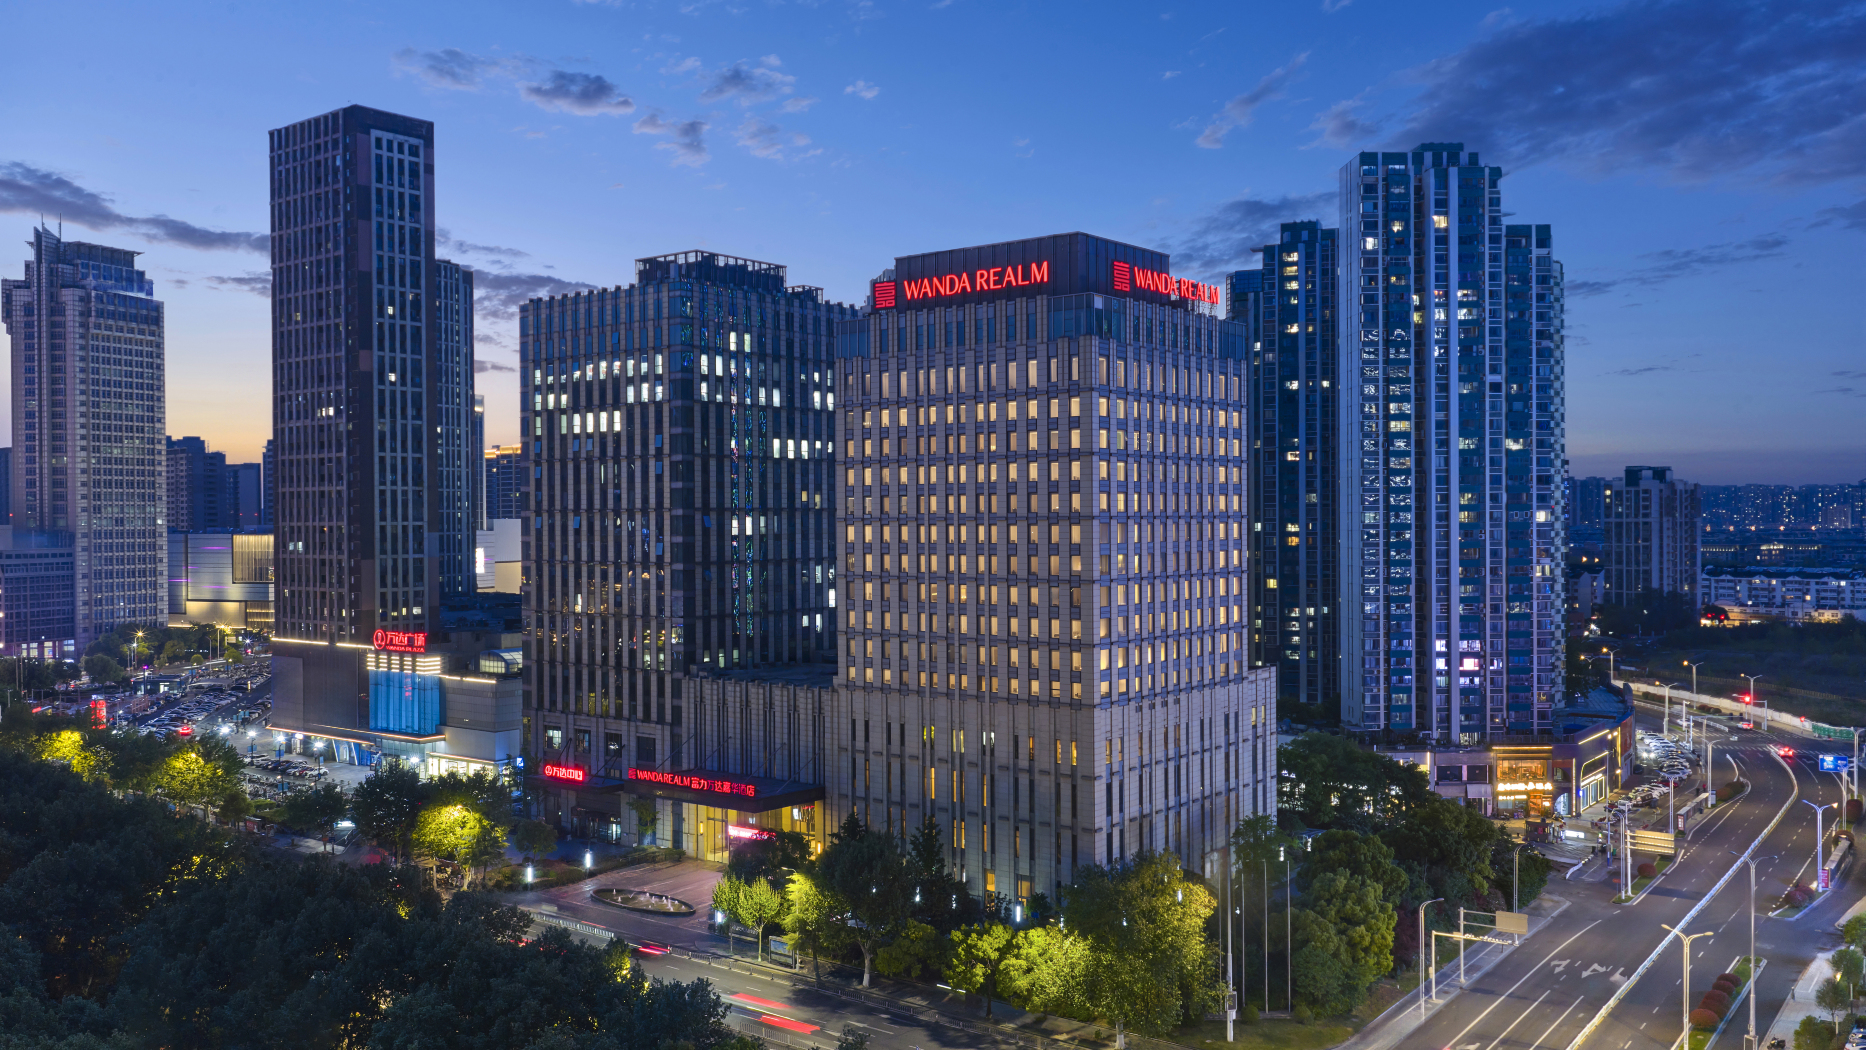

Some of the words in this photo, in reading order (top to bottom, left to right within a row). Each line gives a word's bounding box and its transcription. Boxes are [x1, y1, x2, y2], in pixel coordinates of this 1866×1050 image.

[904, 272, 971, 300] WANDA
[976, 261, 1049, 291] REALM
[1134, 266, 1179, 296] WANDA
[1180, 278, 1220, 305] REALM
[385, 631, 426, 647] 万达广场
[552, 766, 583, 781] 万达中心
[637, 769, 663, 783] WANDA
[663, 773, 690, 787] REALM
[691, 776, 755, 797] 富力万达嘉华酒店
